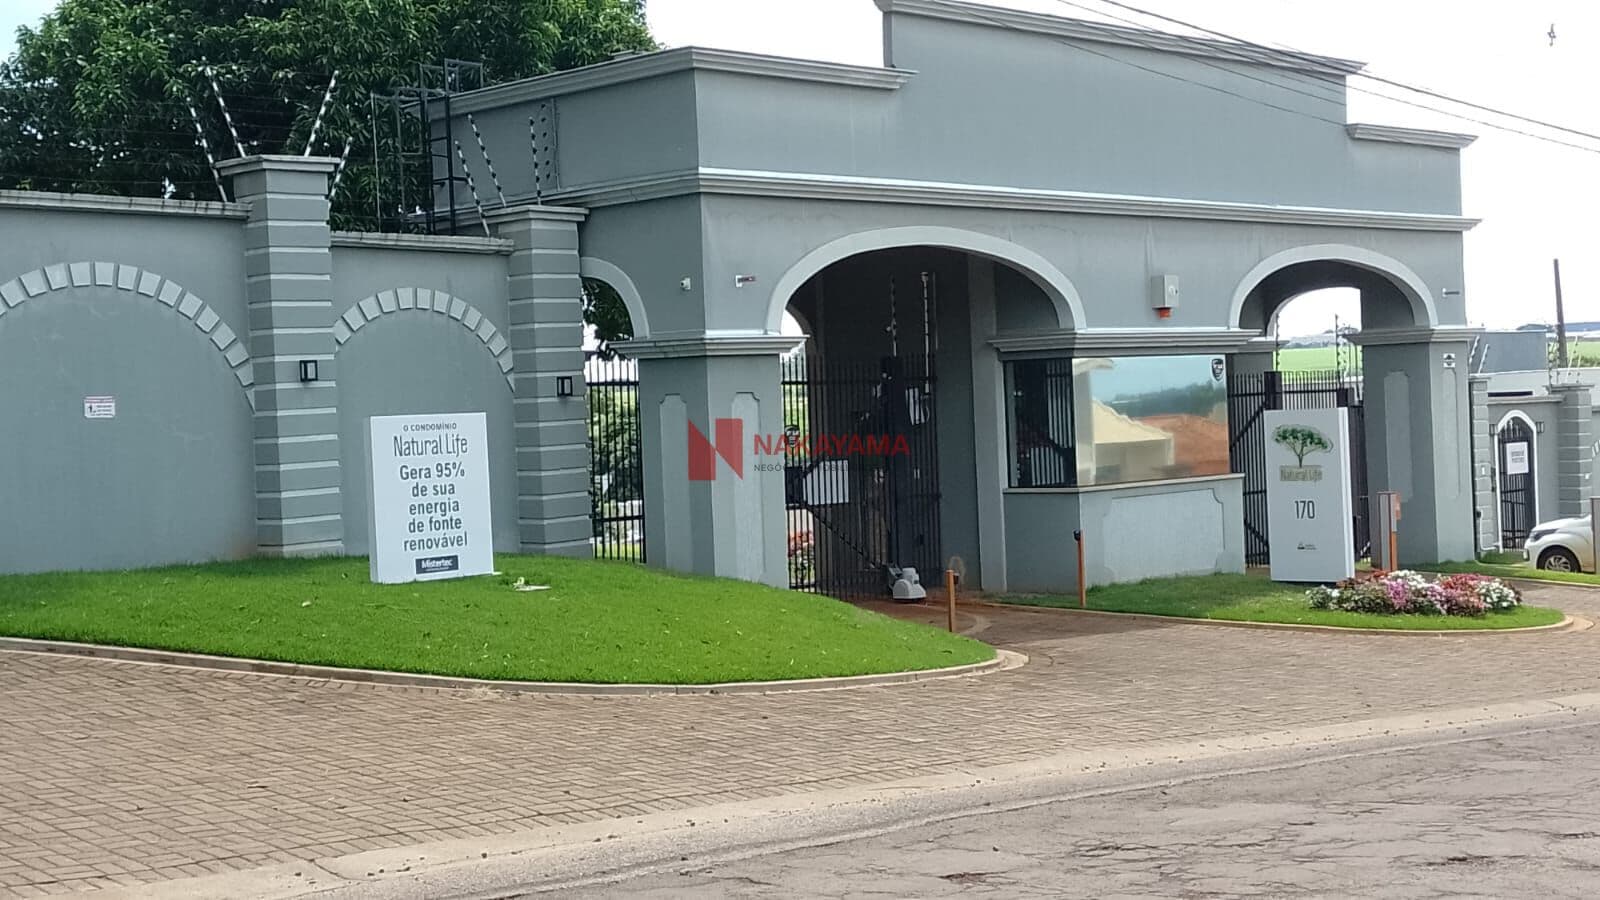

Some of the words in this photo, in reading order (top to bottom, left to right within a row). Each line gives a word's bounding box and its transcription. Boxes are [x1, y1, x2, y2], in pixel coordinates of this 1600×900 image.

[403, 424, 409, 432] O
[410, 422, 457, 432] CONDOMÍNIO
[393, 434, 443, 457] Natural
[446, 433, 468, 457] Life
[400, 465, 431, 480] Gera
[436, 462, 465, 477] 95%
[412, 482, 427, 497] de
[433, 483, 455, 496] sua
[409, 498, 459, 517] energia
[1294, 500, 1315, 519] 170
[408, 518, 424, 533] de
[429, 516, 462, 531] fonte
[404, 531, 467, 551] renovável
